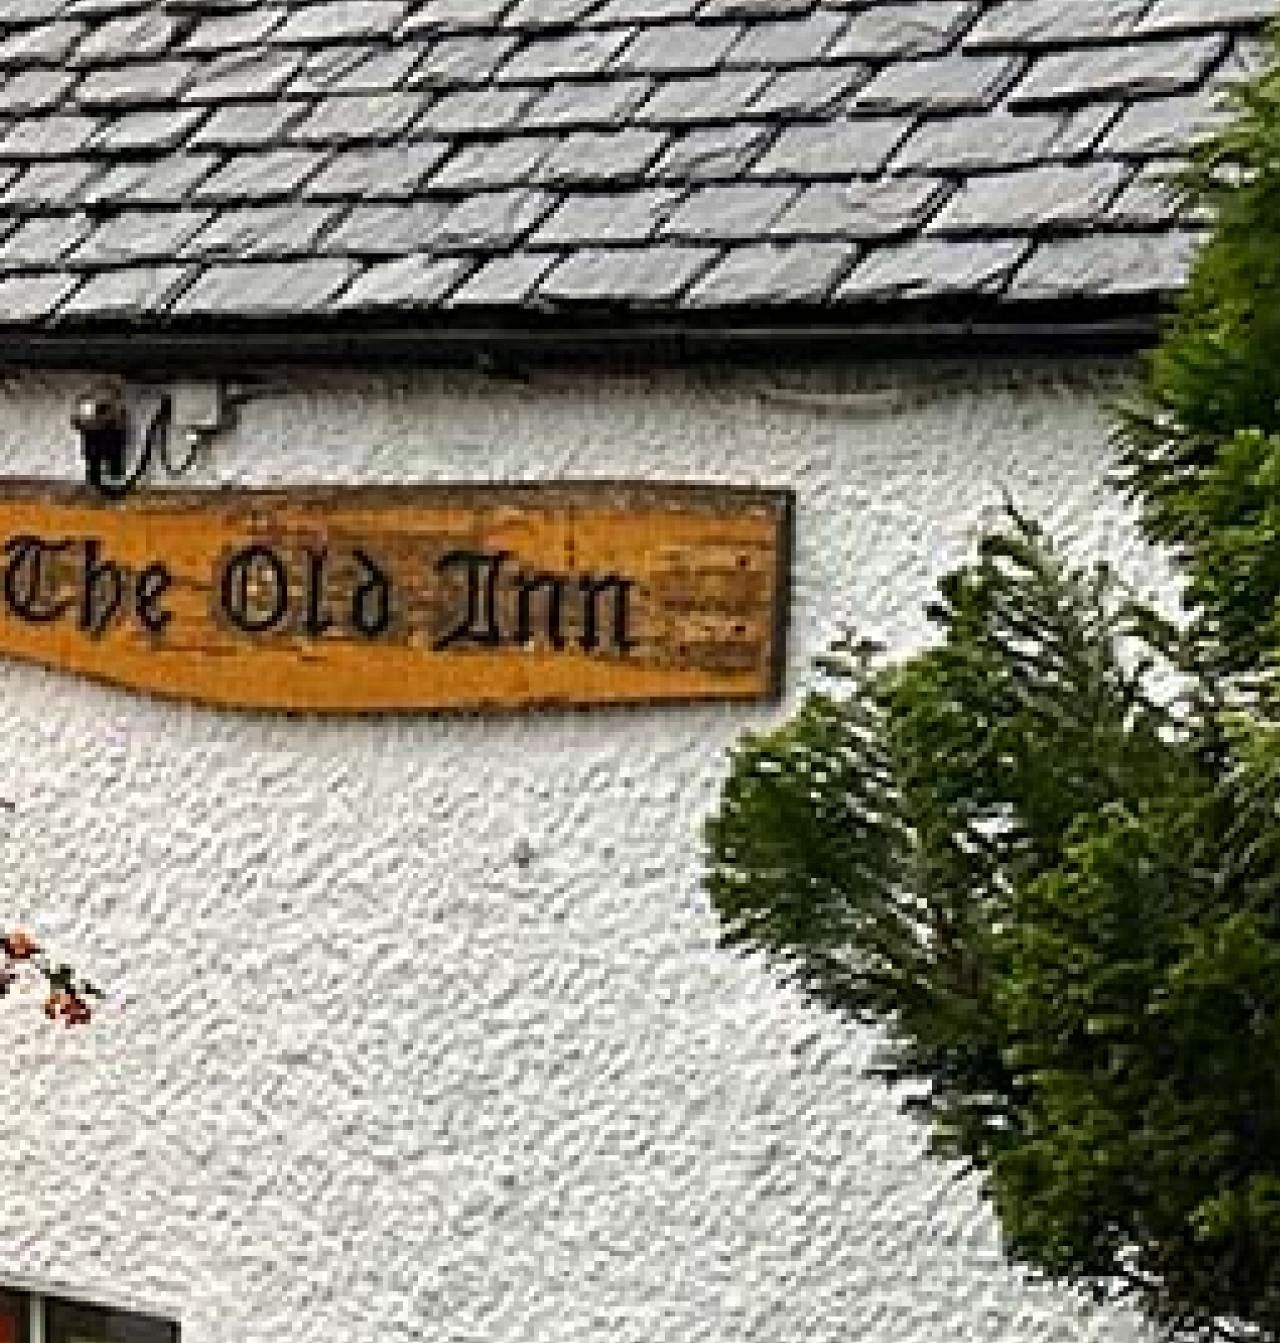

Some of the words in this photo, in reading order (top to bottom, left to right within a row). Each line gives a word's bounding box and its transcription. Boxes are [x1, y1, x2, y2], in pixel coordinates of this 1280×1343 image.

[0, 532, 176, 634] The
[218, 544, 393, 636] Old
[431, 549, 638, 653] Inn
